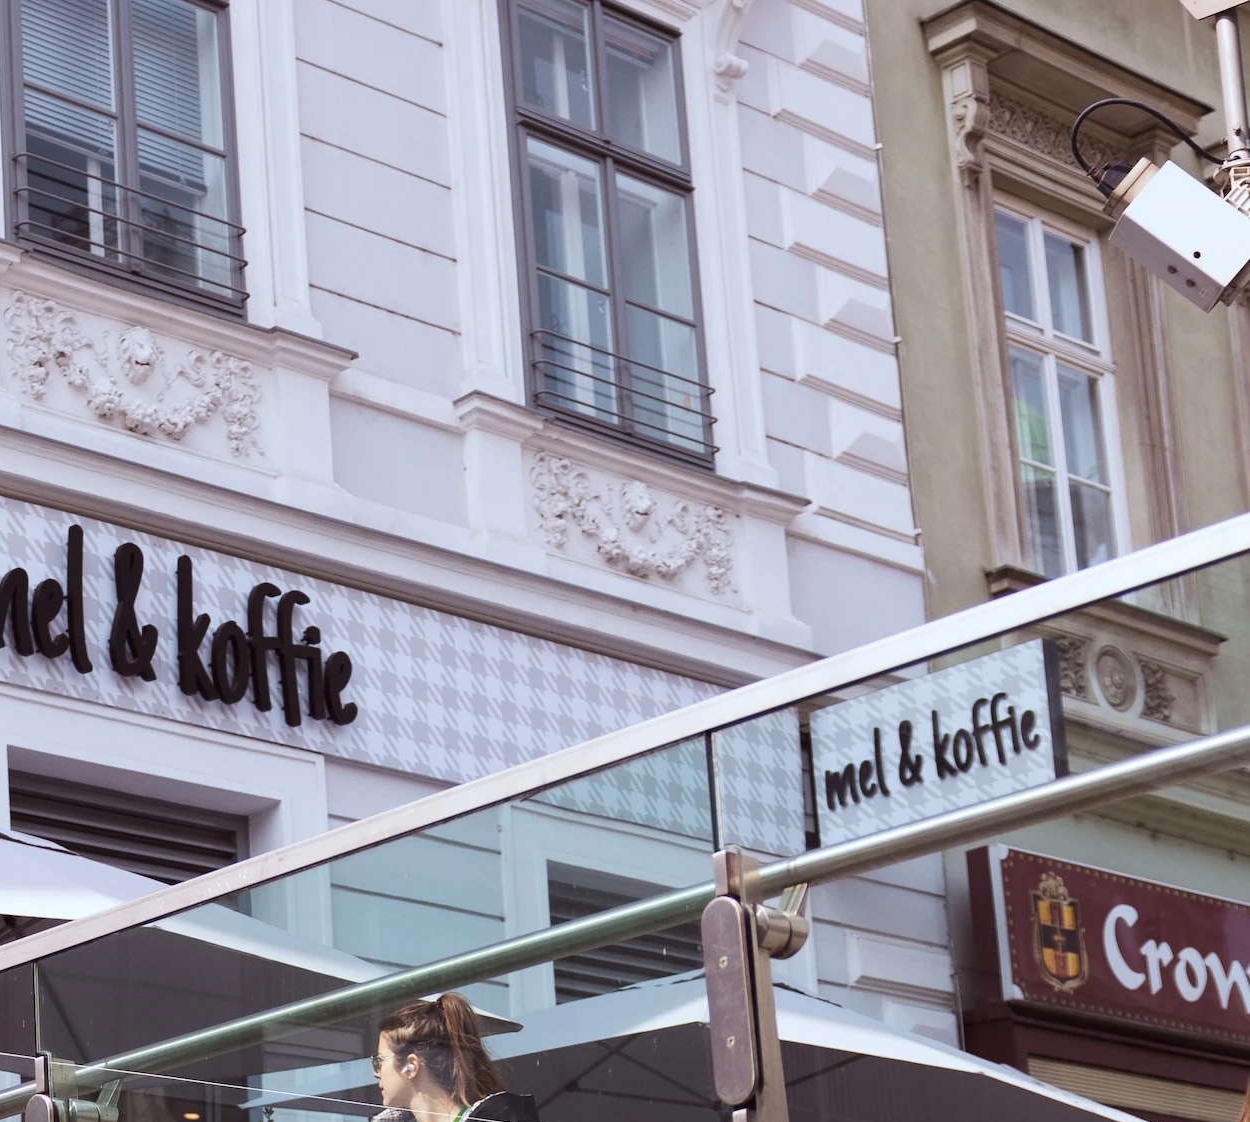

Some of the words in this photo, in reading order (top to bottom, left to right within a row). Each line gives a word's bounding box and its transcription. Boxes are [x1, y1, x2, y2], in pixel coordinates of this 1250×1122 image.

[109, 542, 158, 681] &
[177, 554, 358, 727] koffie
[825, 727, 890, 811] mel
[898, 719, 923, 786] &
[932, 692, 1041, 780] koffie
